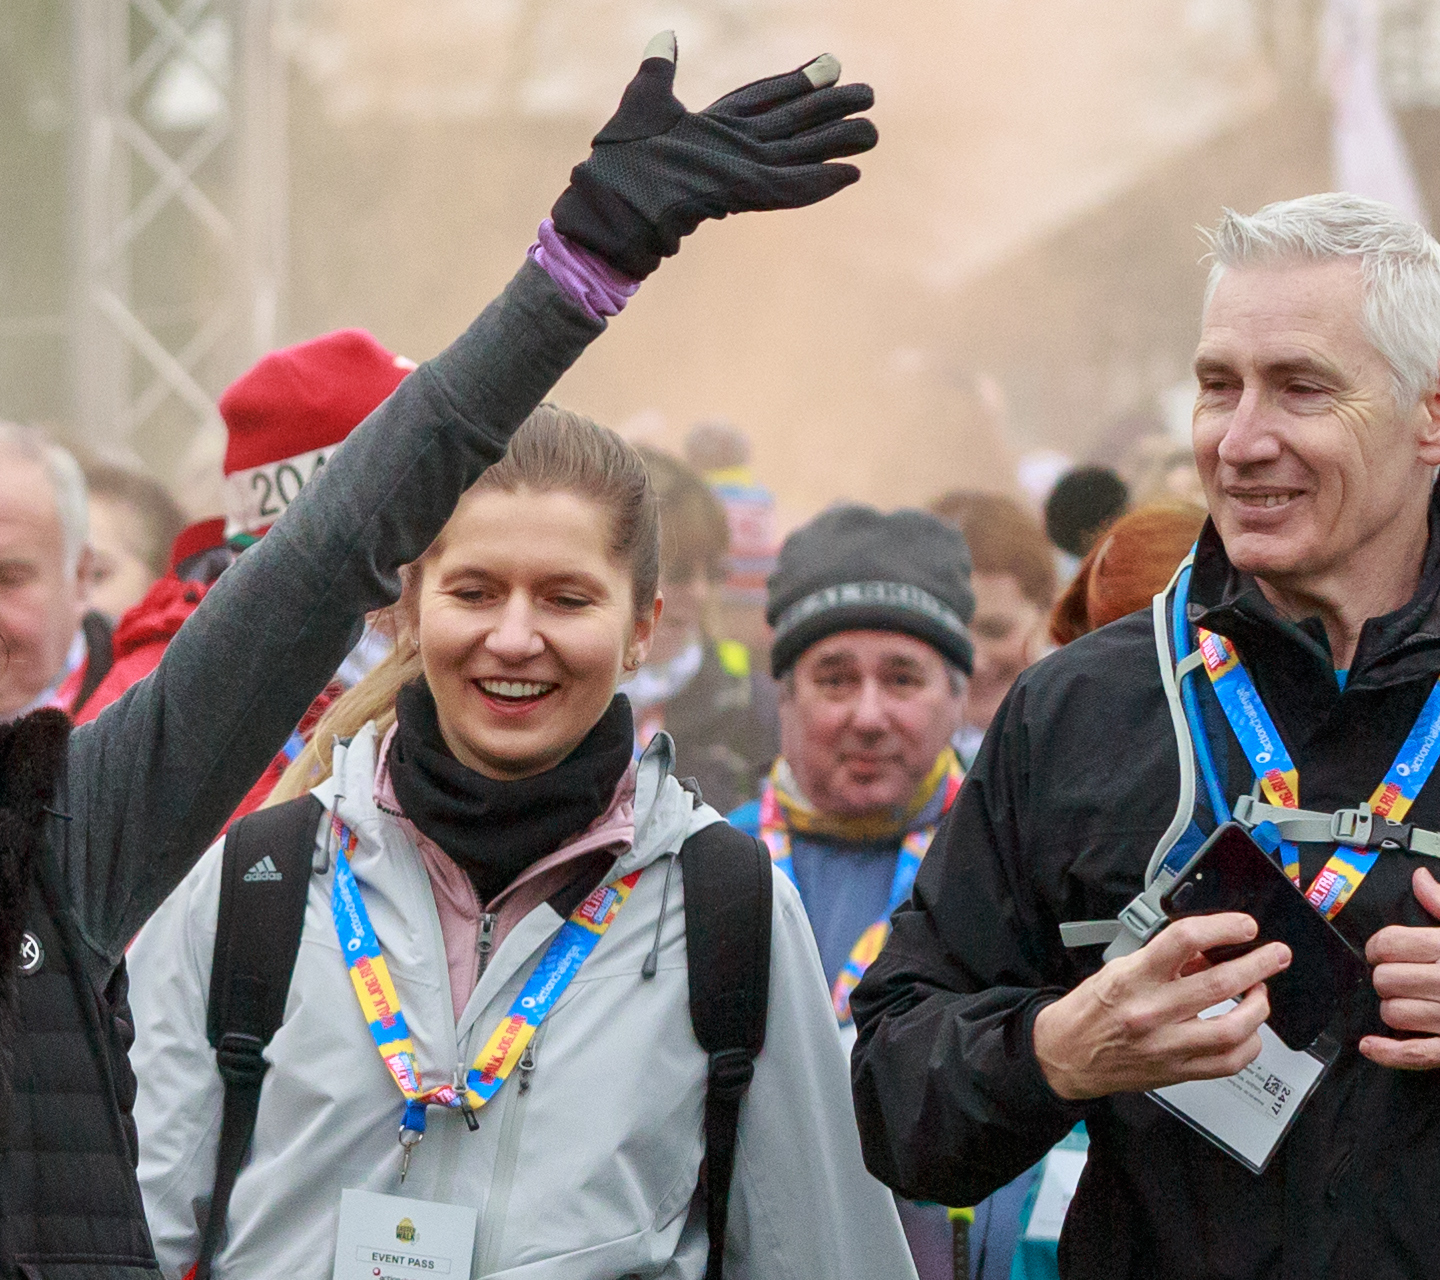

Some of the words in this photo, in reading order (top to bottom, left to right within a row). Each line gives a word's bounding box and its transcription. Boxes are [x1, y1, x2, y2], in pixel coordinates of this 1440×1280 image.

[243, 872, 283, 882] adidas
[1307, 869, 1338, 909] ULTRA
[1271, 1086, 1292, 1116] 2417
[371, 1252, 406, 1265] EVENT
[407, 1257, 435, 1269] PASS
